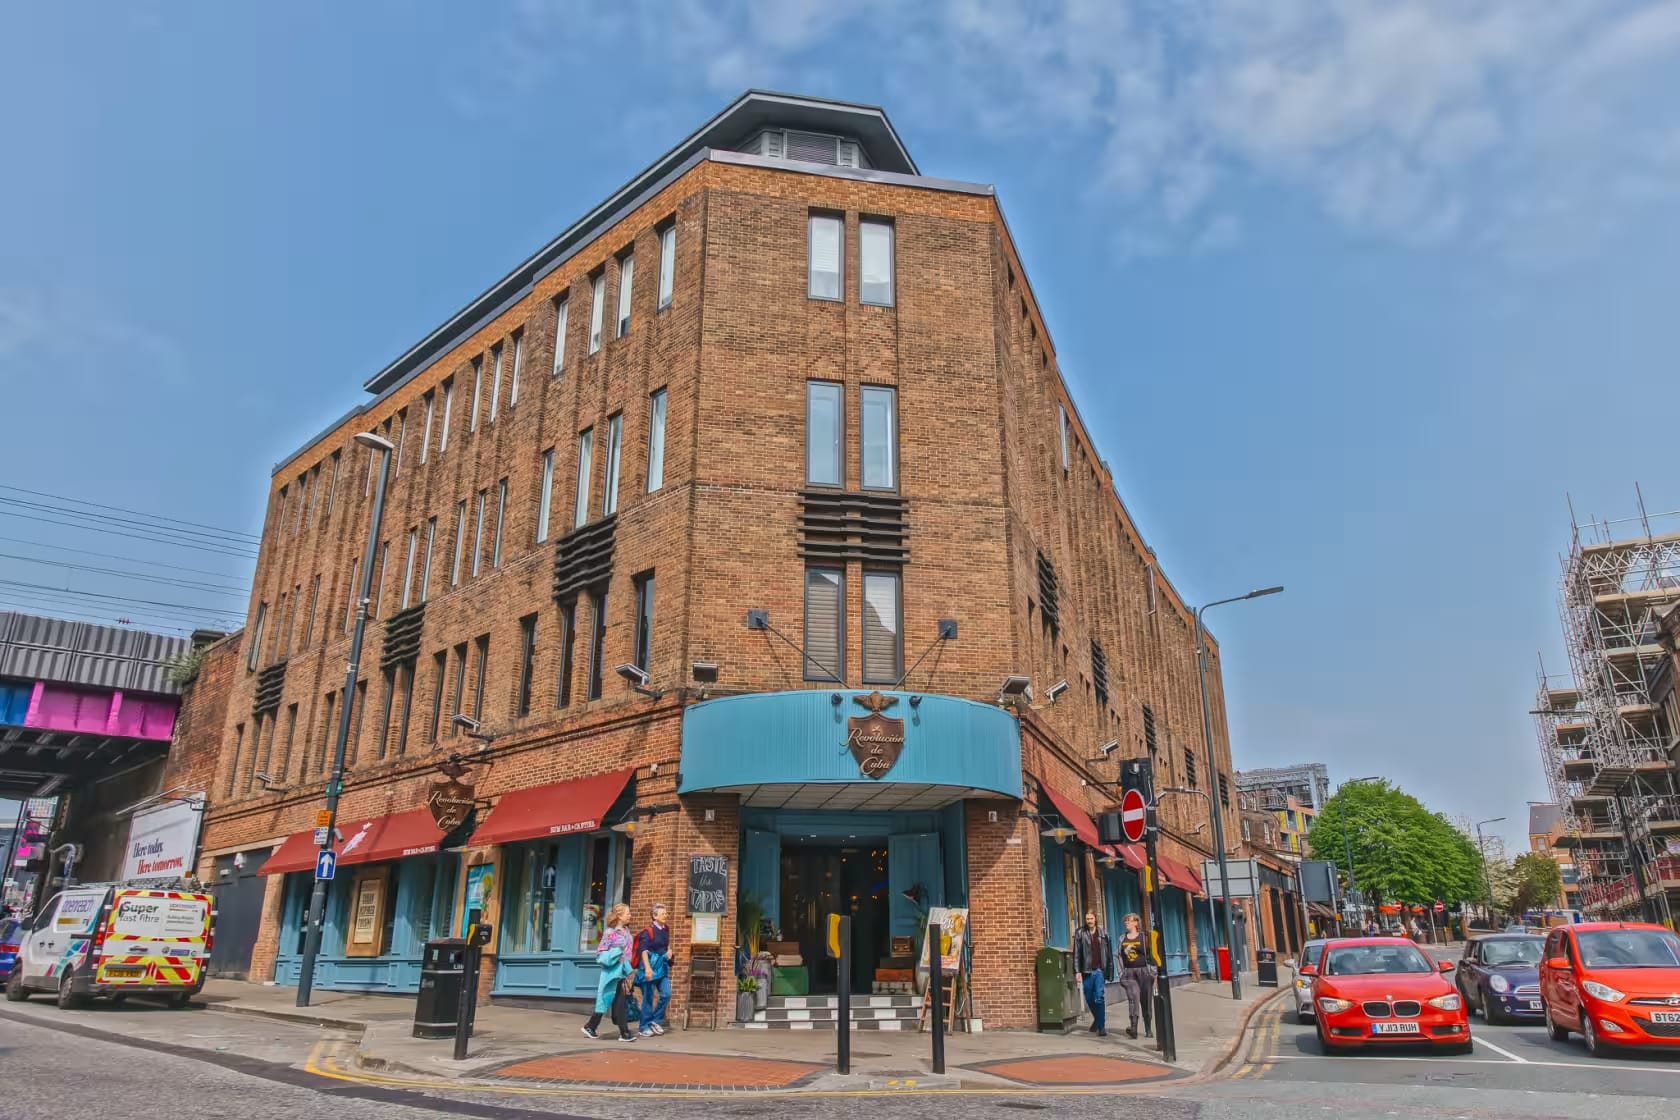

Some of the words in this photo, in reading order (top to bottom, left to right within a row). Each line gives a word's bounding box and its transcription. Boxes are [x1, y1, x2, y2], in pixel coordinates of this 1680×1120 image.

[843, 728, 905, 747] Revolución
[870, 743, 884, 754] de
[860, 757, 890, 775] Cuba
[133, 842, 147, 858] Here
[137, 859, 151, 874] Here
[690, 856, 728, 877] TASTE
[689, 886, 725, 912] TAPAS
[121, 901, 159, 915] Super
[120, 912, 137, 922] fast
[140, 913, 160, 923] fibre
[1655, 1013, 1680, 1022] BT62
[1400, 1023, 1417, 1032] RUH
